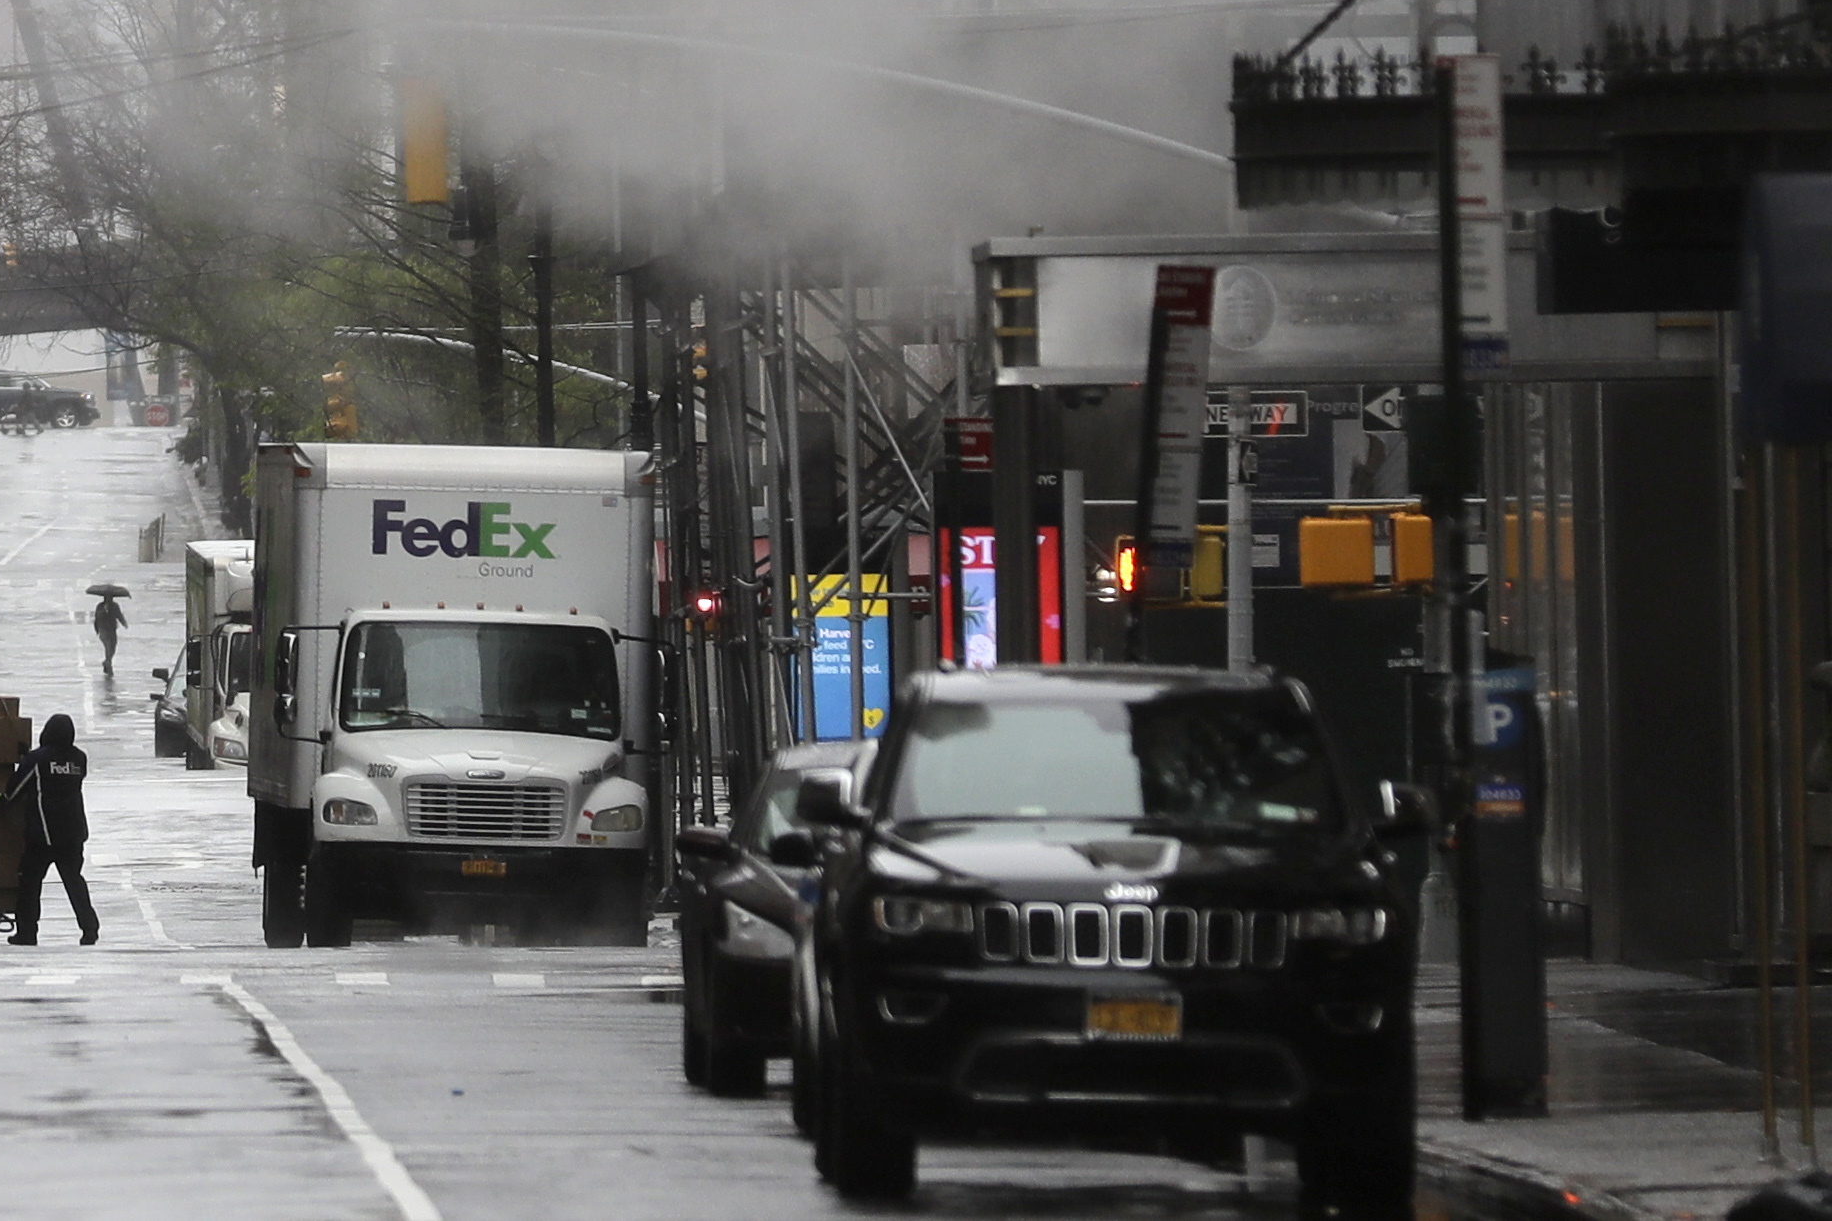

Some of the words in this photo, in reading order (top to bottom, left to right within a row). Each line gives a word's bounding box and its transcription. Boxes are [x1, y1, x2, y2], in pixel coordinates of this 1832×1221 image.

[1251, 404, 1289, 423] WAY
[372, 499, 557, 559] FedEx
[478, 563, 533, 578] Ground
[820, 628, 851, 639] Harve
[823, 640, 848, 650] feed
